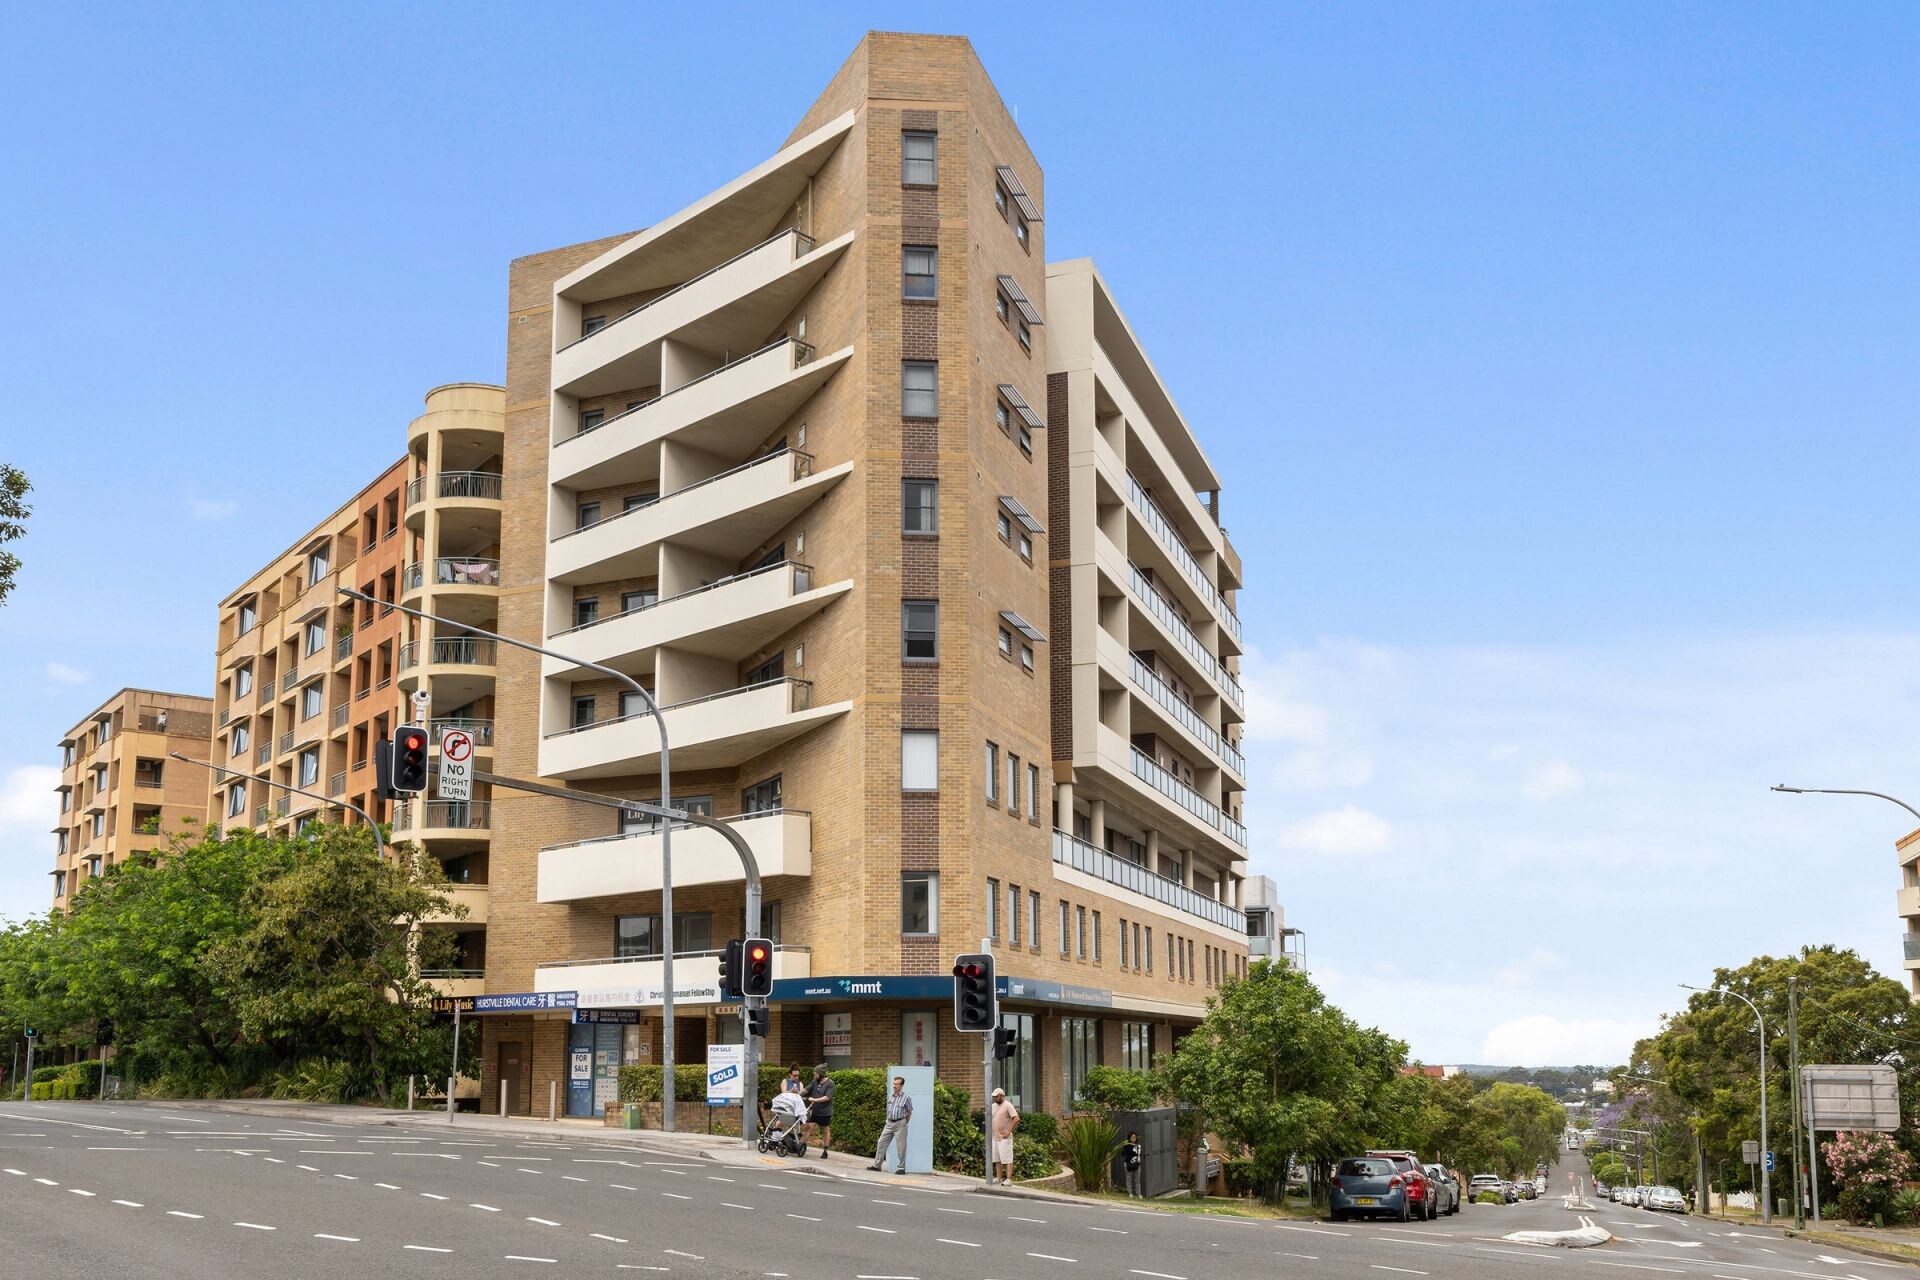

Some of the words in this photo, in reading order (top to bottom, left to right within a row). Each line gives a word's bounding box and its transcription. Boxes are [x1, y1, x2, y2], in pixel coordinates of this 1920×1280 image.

[447, 764, 464, 775] NO
[441, 777, 469, 787] RIGHT
[442, 786, 467, 797] TURN
[851, 981, 882, 994] mmt
[440, 999, 452, 1012] Lily
[477, 997, 503, 1009] HURSTVILLE
[503, 996, 522, 1008] DENTAL
[522, 994, 537, 1007] CARE
[575, 1054, 588, 1062] FOR
[574, 1064, 588, 1073] SALE
[712, 1068, 734, 1083] SOLD
